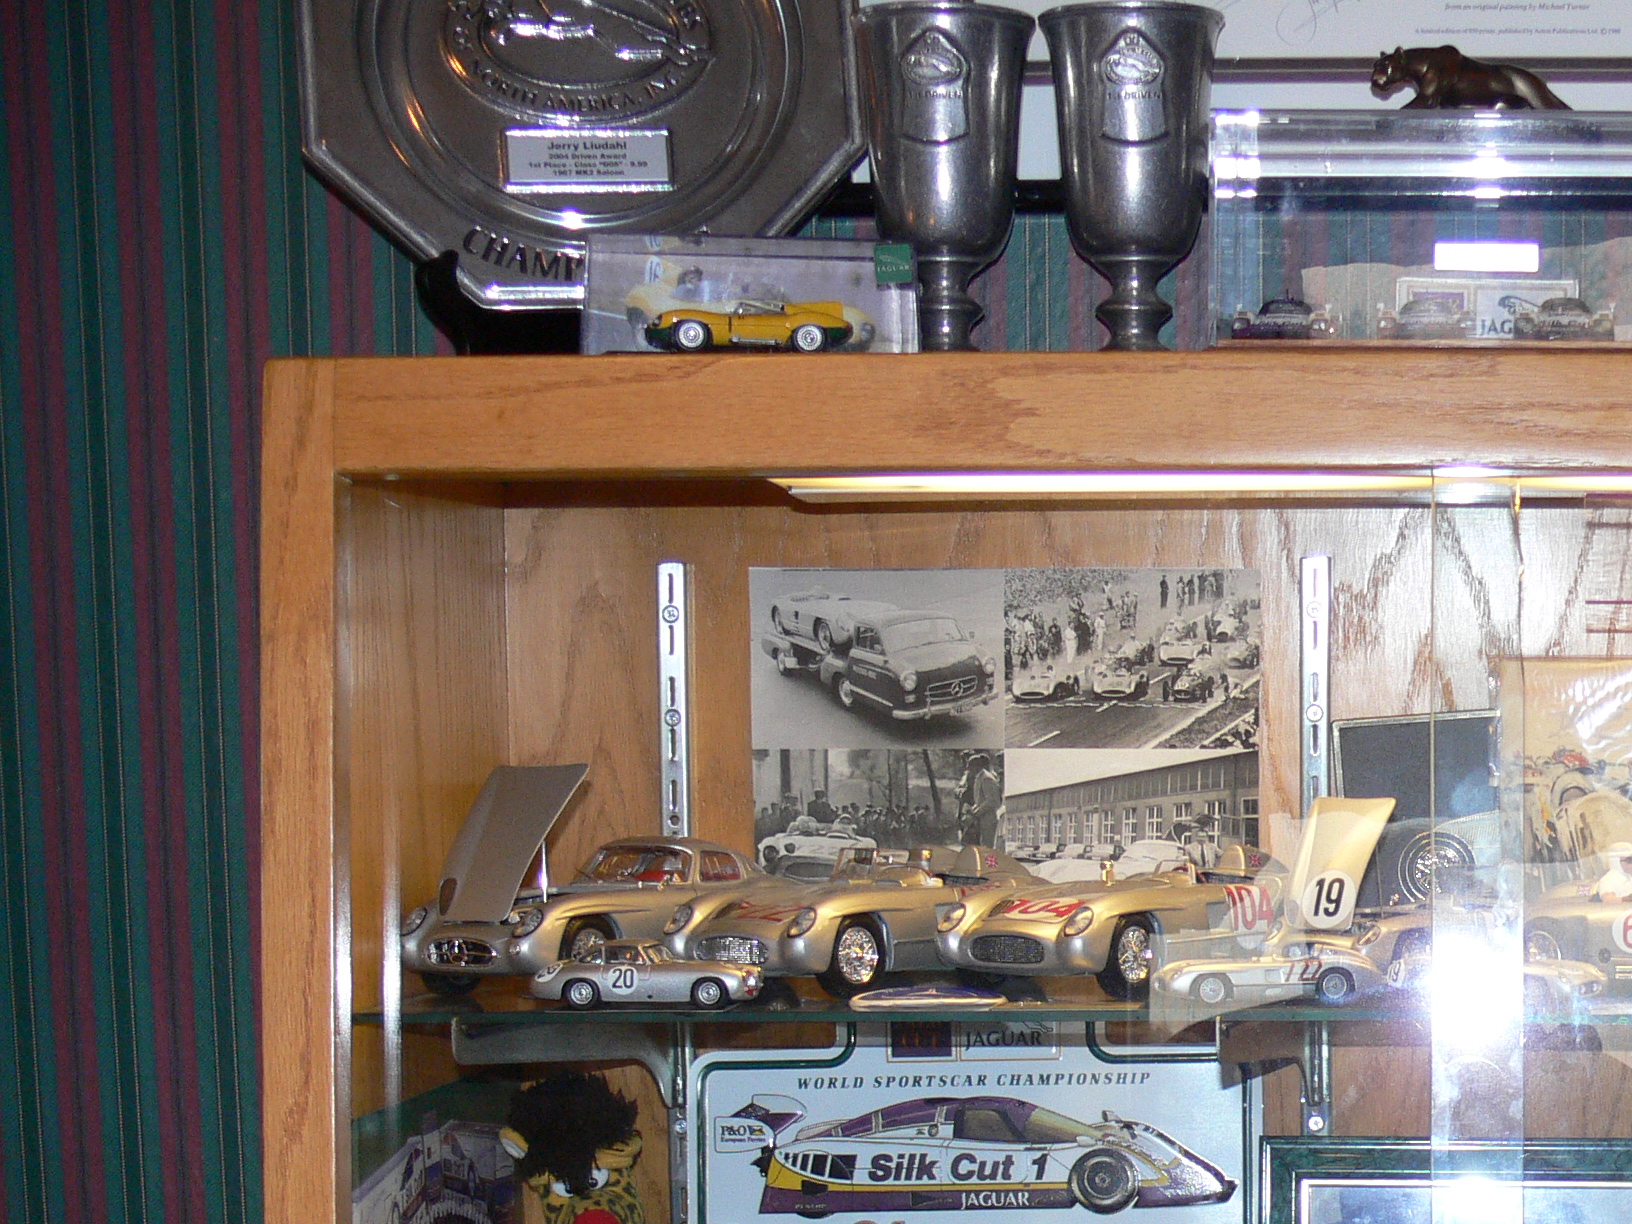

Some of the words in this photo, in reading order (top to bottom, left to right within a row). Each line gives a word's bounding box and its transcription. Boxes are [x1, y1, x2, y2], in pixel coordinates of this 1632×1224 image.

[547, 141, 579, 151] Jerry
[1313, 877, 1345, 918] 19
[611, 968, 636, 989] 20
[965, 1031, 1043, 1051] JAGUAR
[797, 1076, 865, 1090] WORLD
[872, 1074, 987, 1089] SPORTSCAR
[996, 1072, 1151, 1087] CHAMPIONSHIP
[868, 1152, 940, 1182] Silk
[950, 1152, 1015, 1182] Cut
[1031, 1152, 1050, 1181] 1
[960, 1190, 1030, 1210] JAGUAR
